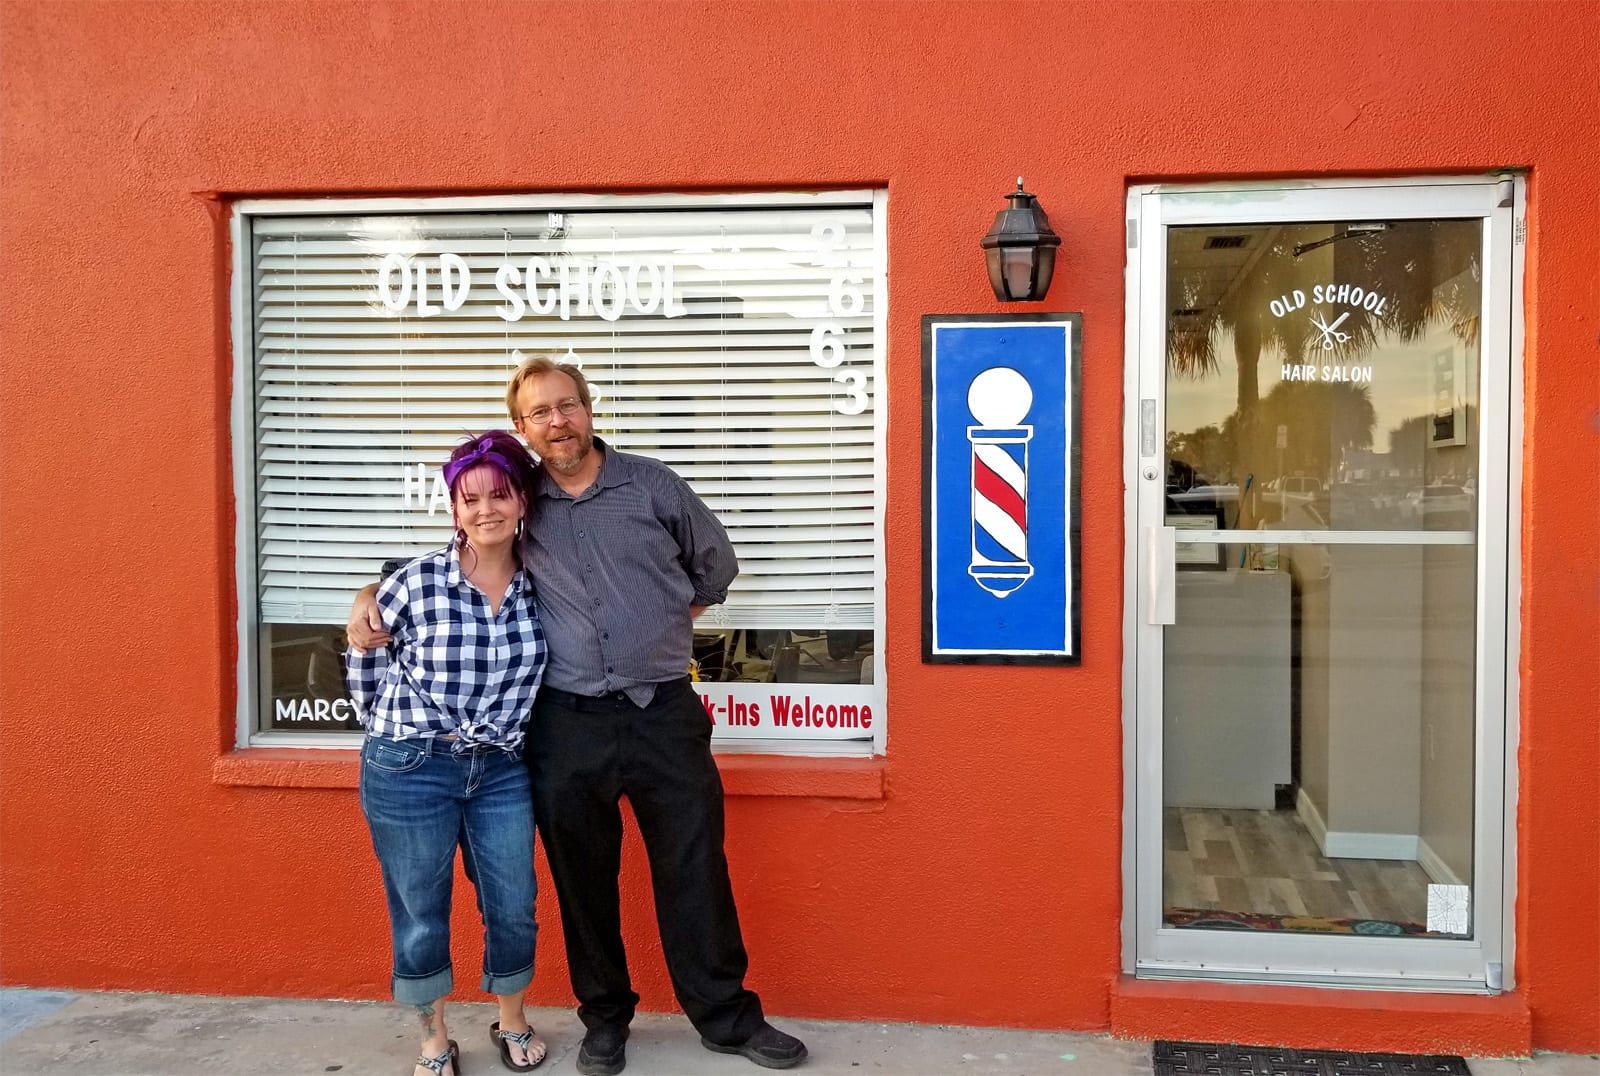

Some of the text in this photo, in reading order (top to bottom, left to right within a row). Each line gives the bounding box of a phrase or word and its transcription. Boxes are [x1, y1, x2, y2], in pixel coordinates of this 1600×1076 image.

[378, 253, 687, 322] OLD SCHOOL
[1269, 284, 1387, 318] OLD SCHOOL
[1281, 363, 1372, 383] HAIR SALON
[404, 462, 454, 517] HA
[698, 694, 873, 729] k-Ins Welcome
